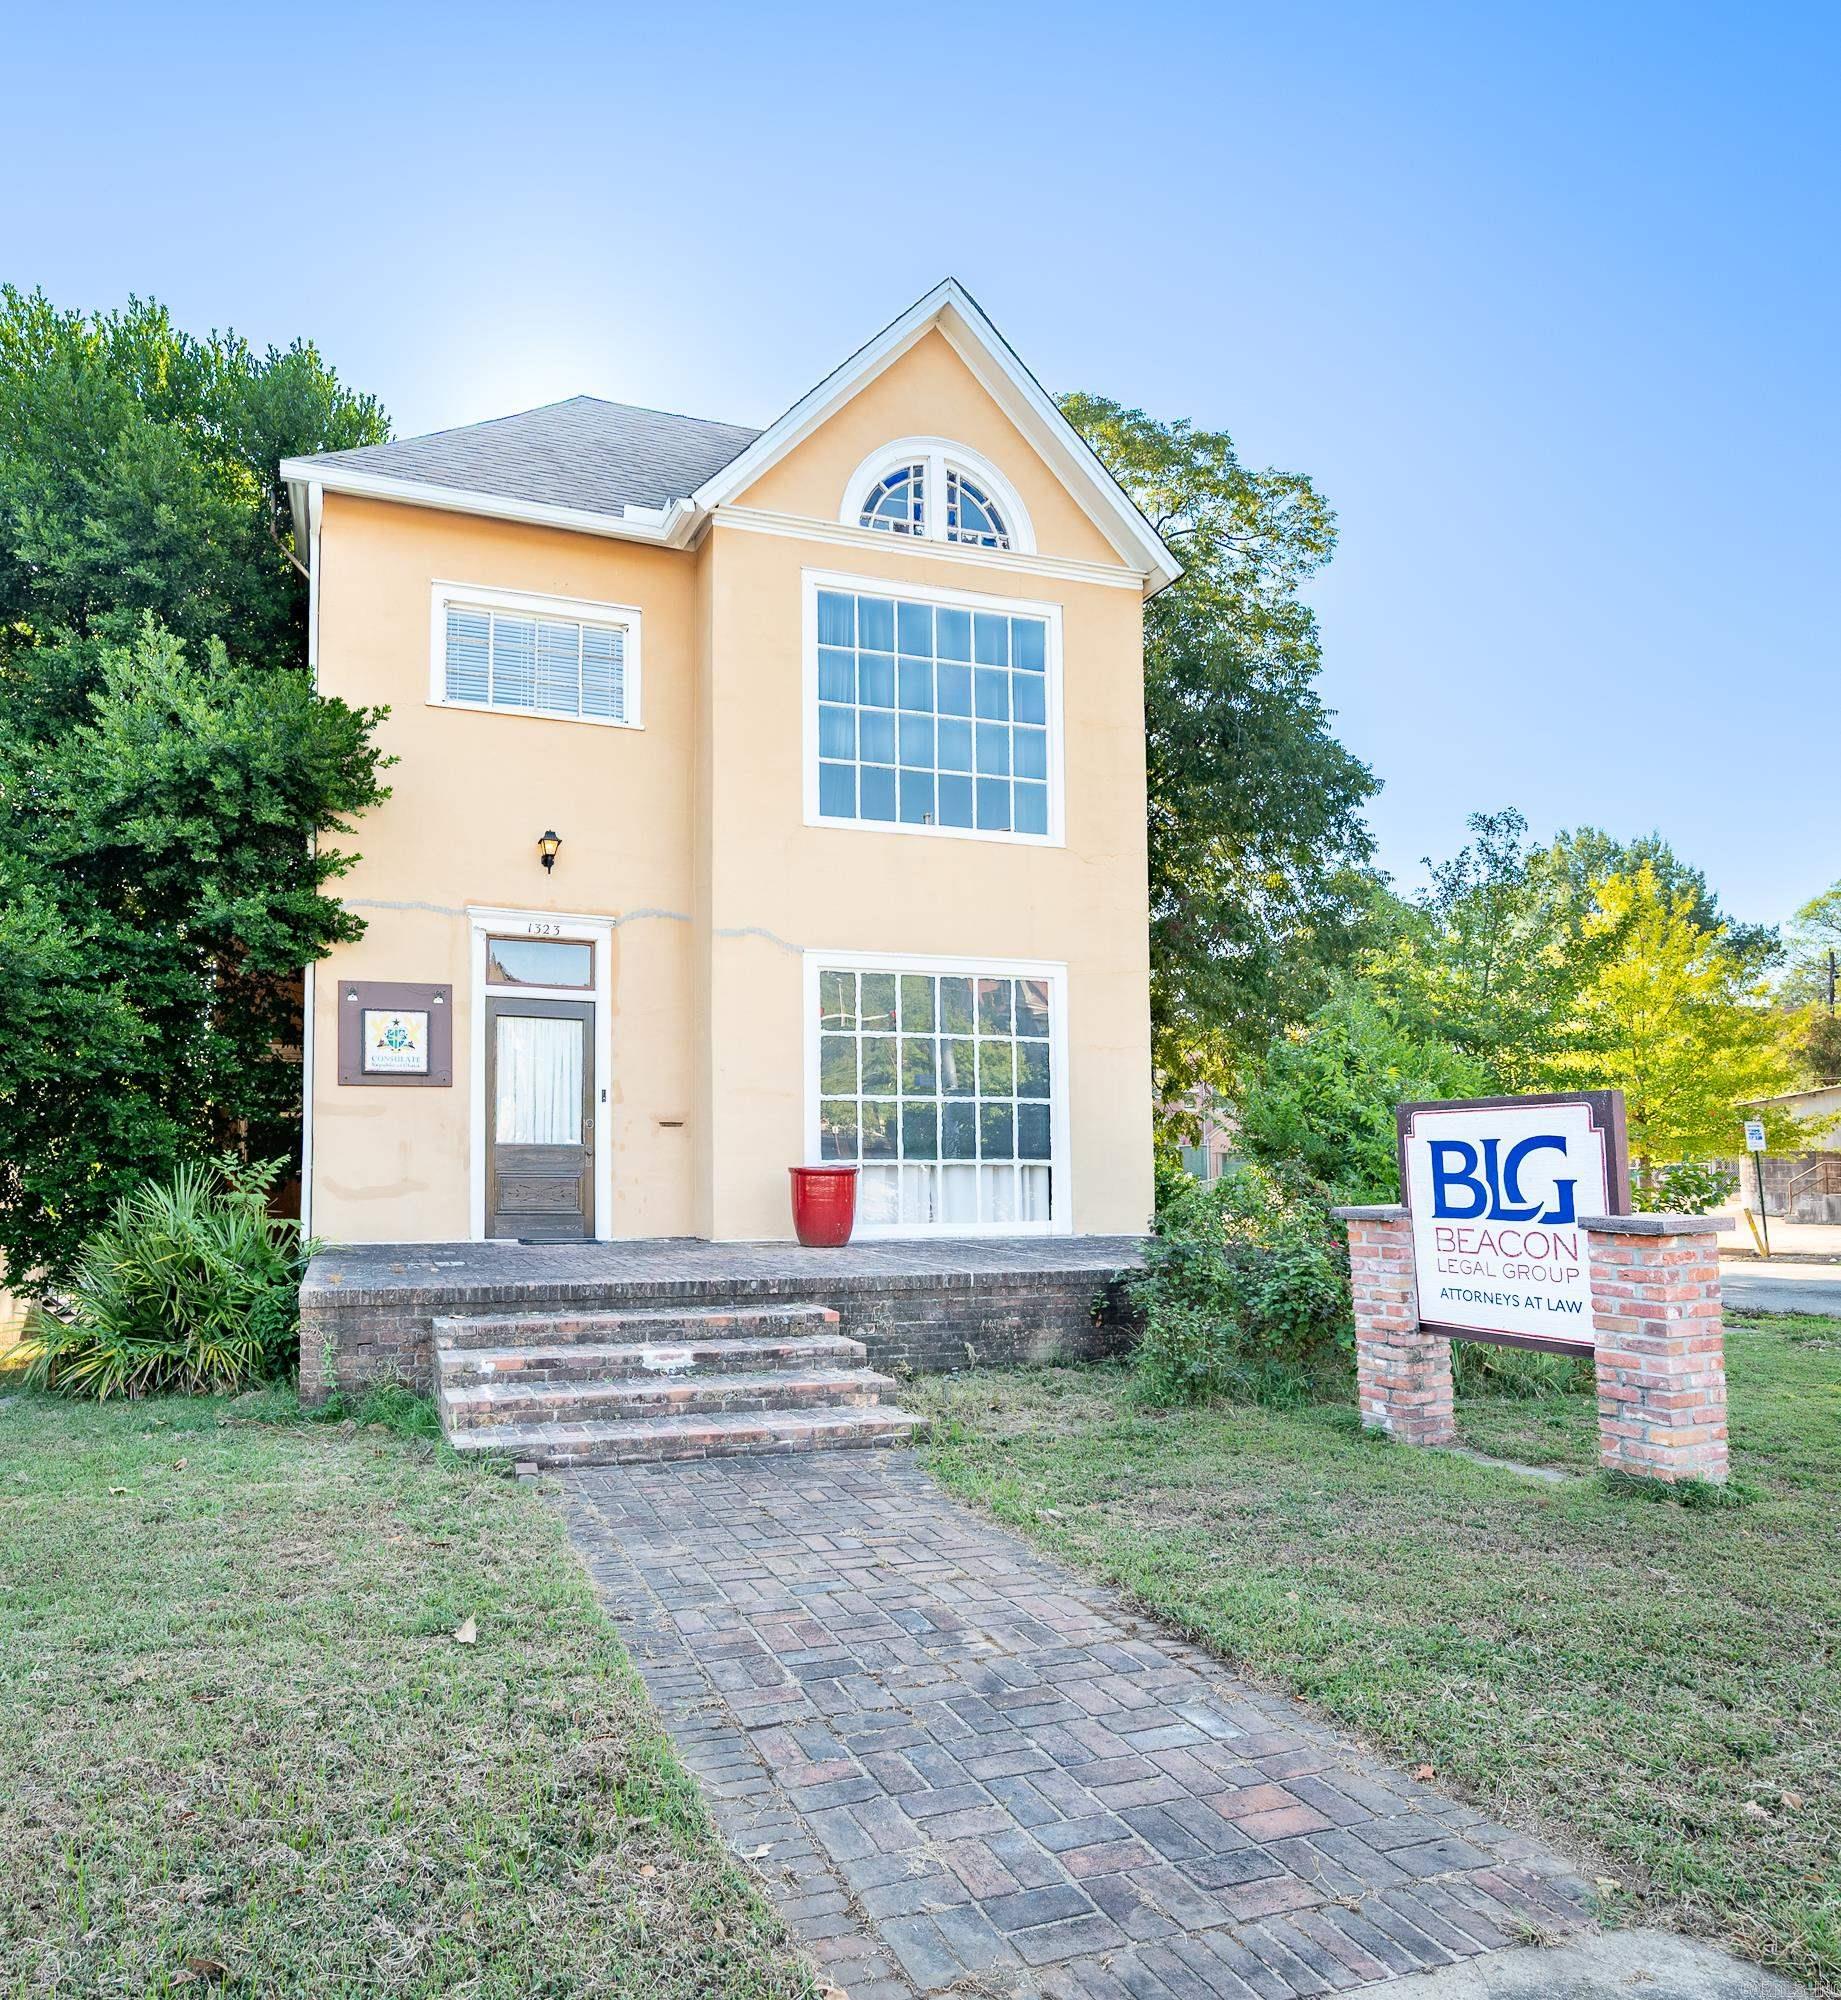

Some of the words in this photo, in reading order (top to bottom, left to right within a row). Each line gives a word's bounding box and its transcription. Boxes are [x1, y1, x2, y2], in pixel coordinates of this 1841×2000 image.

[528, 923, 560, 936] 1323
[1427, 1134, 1578, 1225] BLG
[1435, 1227, 1578, 1261] BEACON
[1437, 1258, 1497, 1277] LEGAL
[1502, 1263, 1580, 1283] GROUP
[1440, 1287, 1520, 1307] ATTORNEYS
[1524, 1296, 1542, 1309] AT
[1547, 1298, 1583, 1314] LAW
